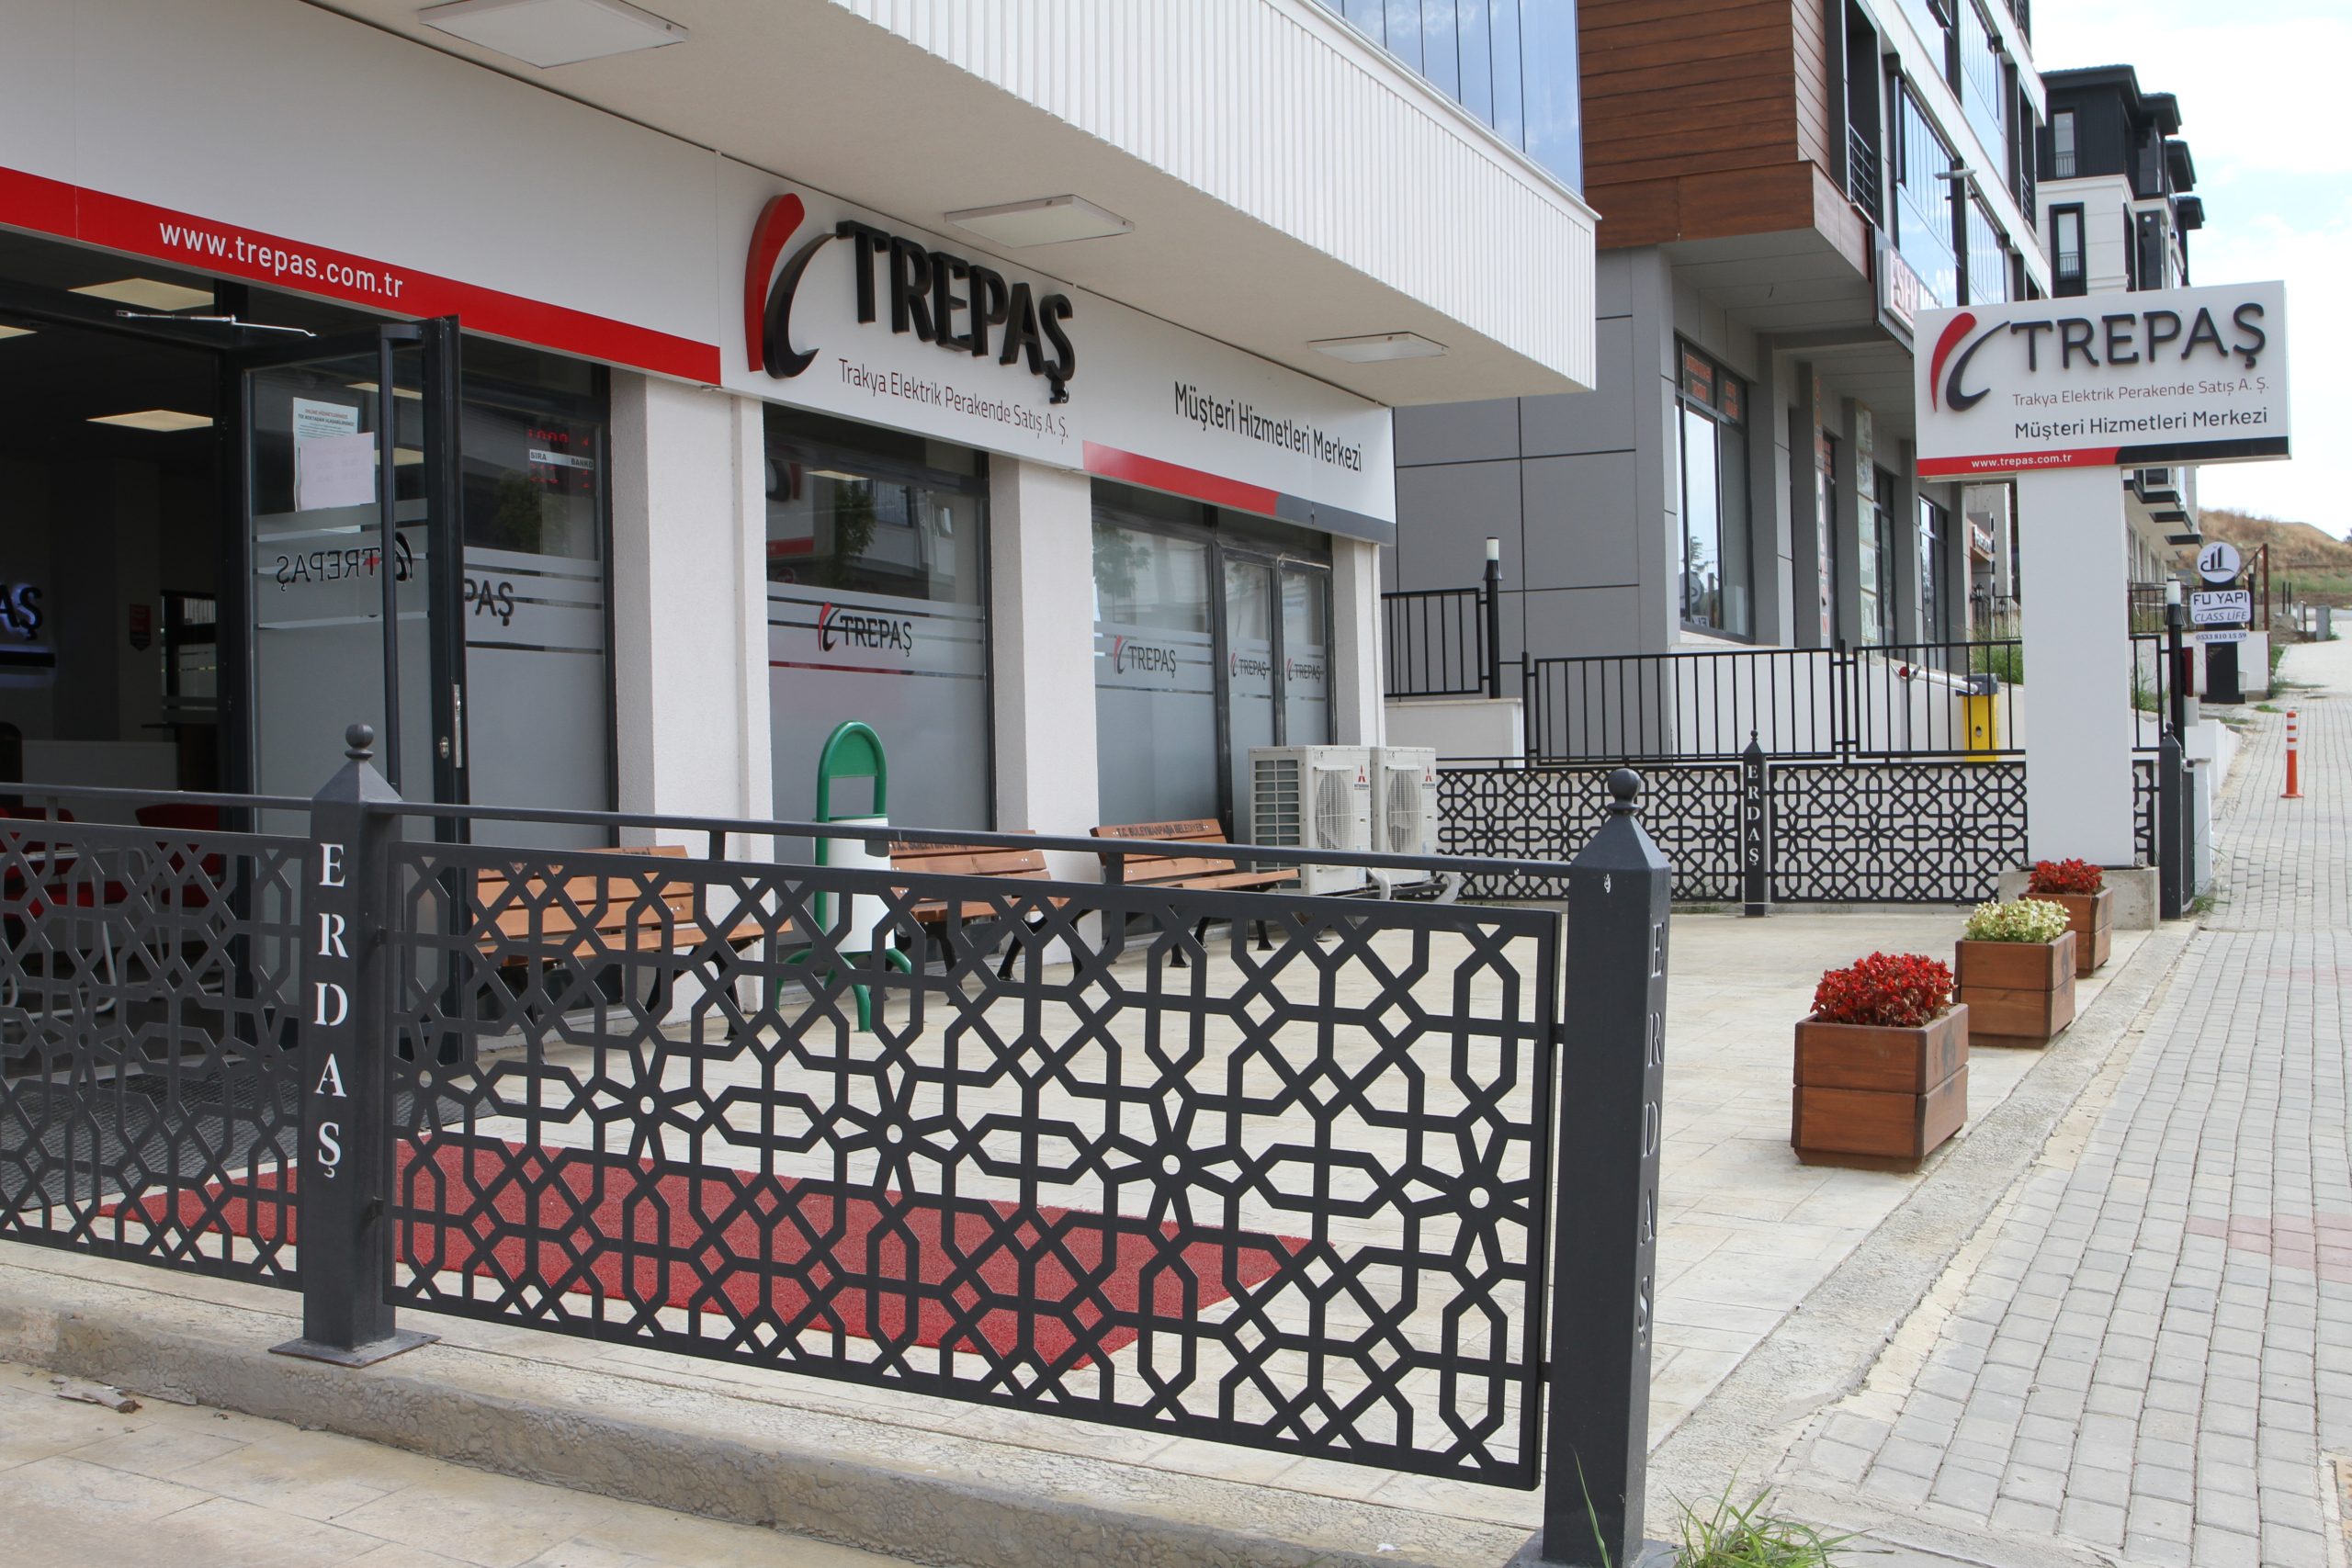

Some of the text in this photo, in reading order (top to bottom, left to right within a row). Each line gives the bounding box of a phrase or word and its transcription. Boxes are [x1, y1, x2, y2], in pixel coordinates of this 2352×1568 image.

[159, 222, 404, 299] www.trepas.com.tr
[836, 220, 1076, 404] TREPAŞ
[2009, 302, 2267, 372] TREPAŞ
[838, 358, 1069, 446] Trakya Elektrik Perakende Satış A. Ş.
[2012, 377, 2269, 409] Trakya Elektrik Perakende Satış A. Ş.
[1174, 380, 1363, 473] Müşteri Hizmetleri Merkezi
[2015, 407, 2267, 442] Müşteri Hizmetleri Merkezi
[530, 451, 547, 461] SIRA
[1972, 452, 2072, 469] www.trepas.com.tr
[2194, 592, 2247, 605] FU YAPI
[2194, 609, 2247, 623] CLASS LİFE
[840, 615, 912, 658] TREPAŞ
[1128, 646, 1176, 678] TREPAŞ
[1238, 659, 1268, 681] TREPAŞ
[1294, 664, 1321, 683] TREPAŞ
[1747, 764, 1761, 865] ERDAŞ
[313, 842, 349, 1179] ERDAŞ
[1638, 921, 1666, 1348] ERDAŞ
